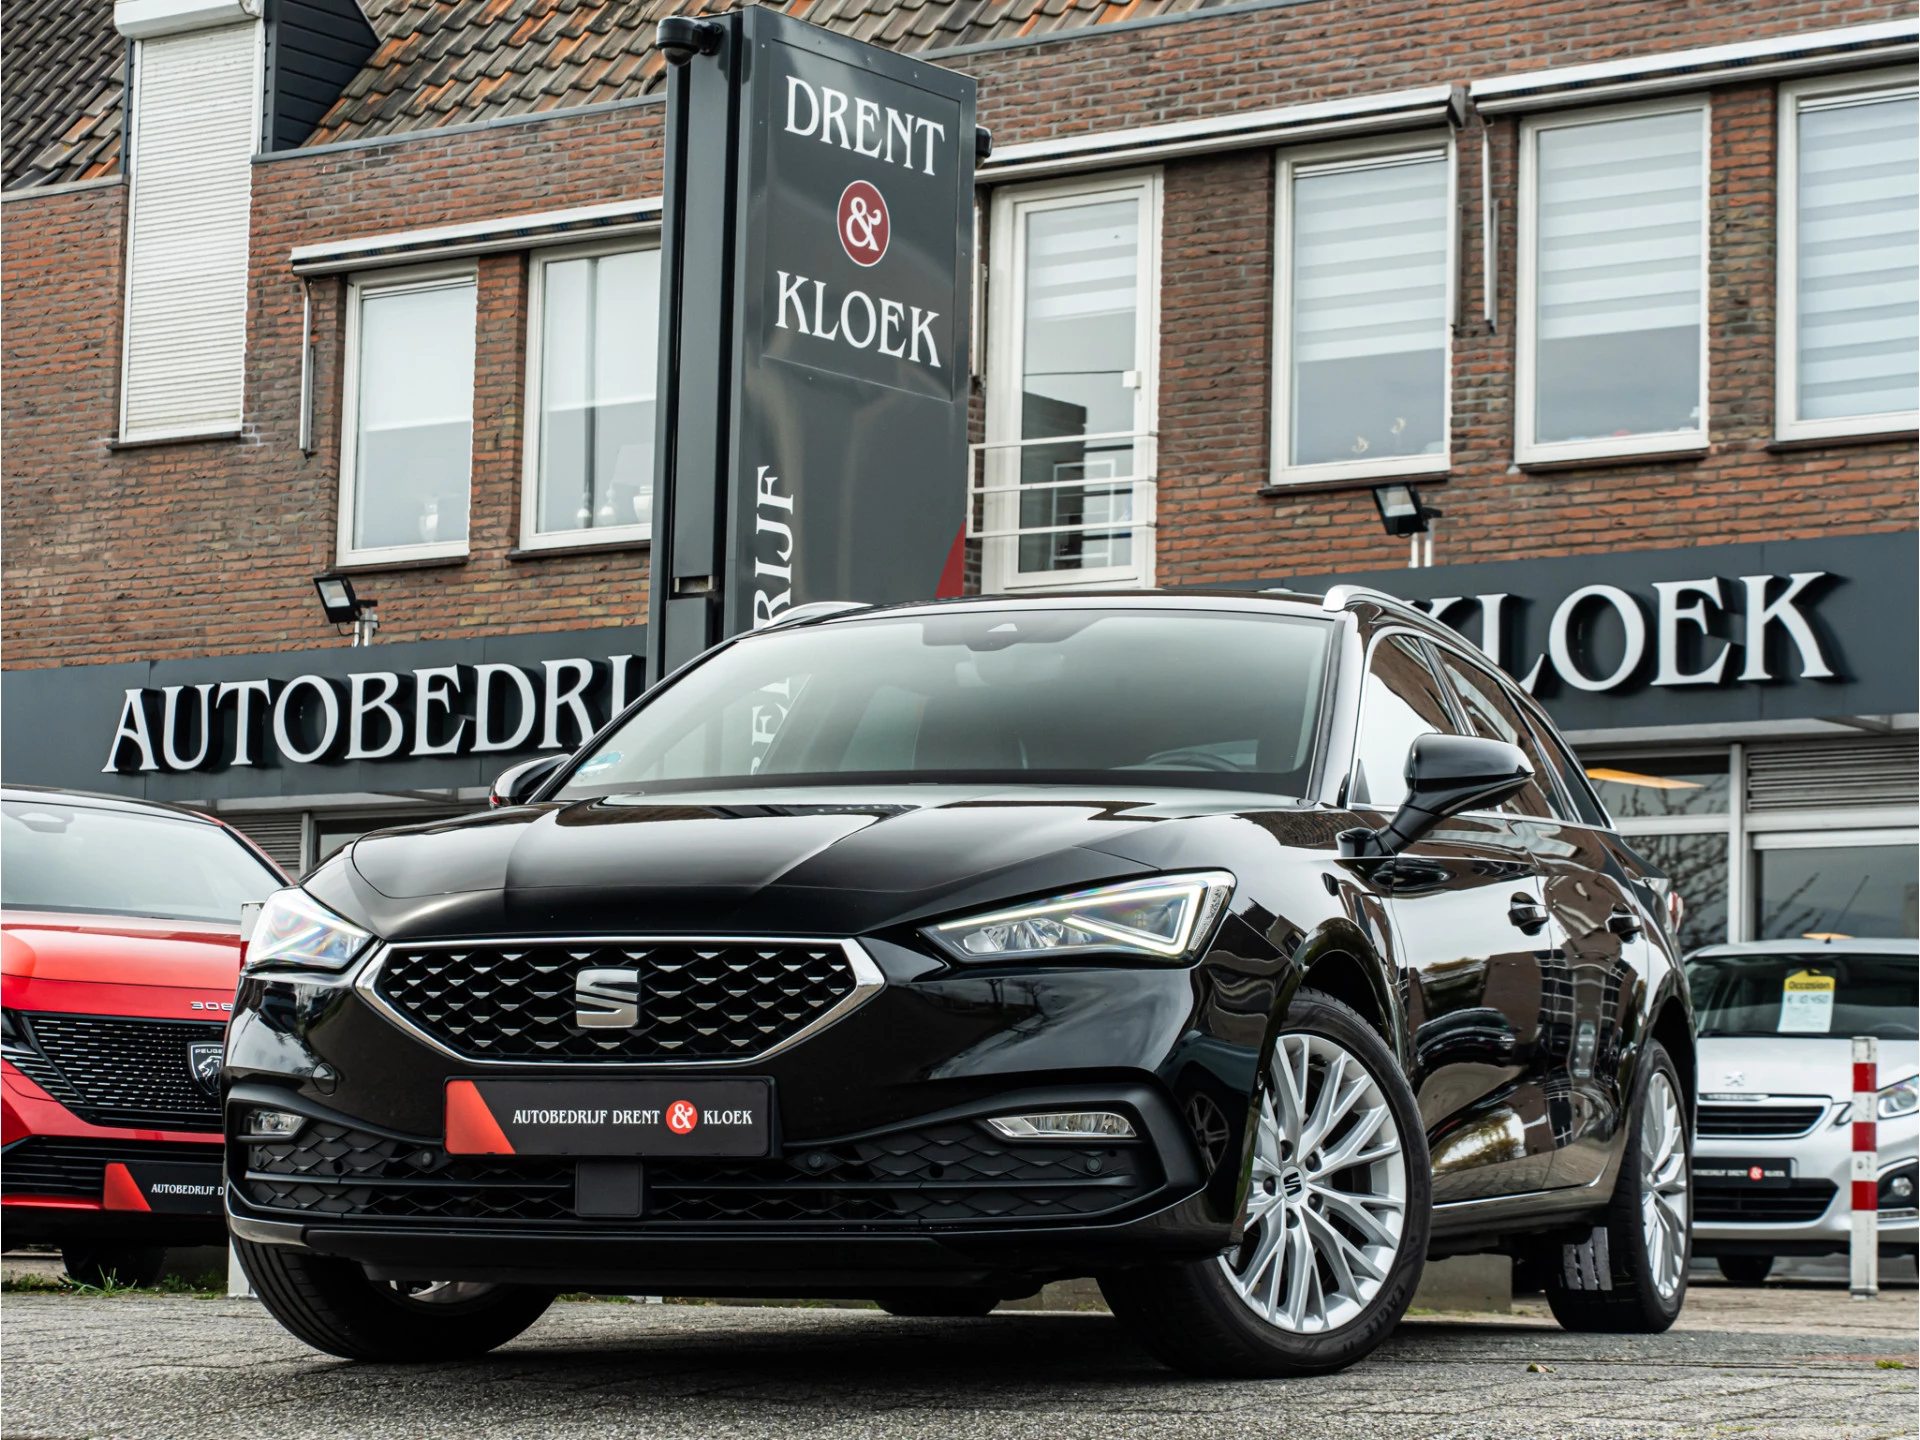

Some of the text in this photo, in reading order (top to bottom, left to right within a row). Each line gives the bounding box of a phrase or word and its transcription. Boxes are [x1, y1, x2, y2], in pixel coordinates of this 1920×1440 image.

[783, 75, 945, 176] DRENT
[845, 196, 882, 252] &
[775, 270, 942, 368] KLOEK
[190, 1001, 233, 1011] 308
[512, 1103, 753, 1129] AUTOBEDRIJF DRENT & KLOEK
[151, 1183, 215, 1196] AUTOBEDRIJF
